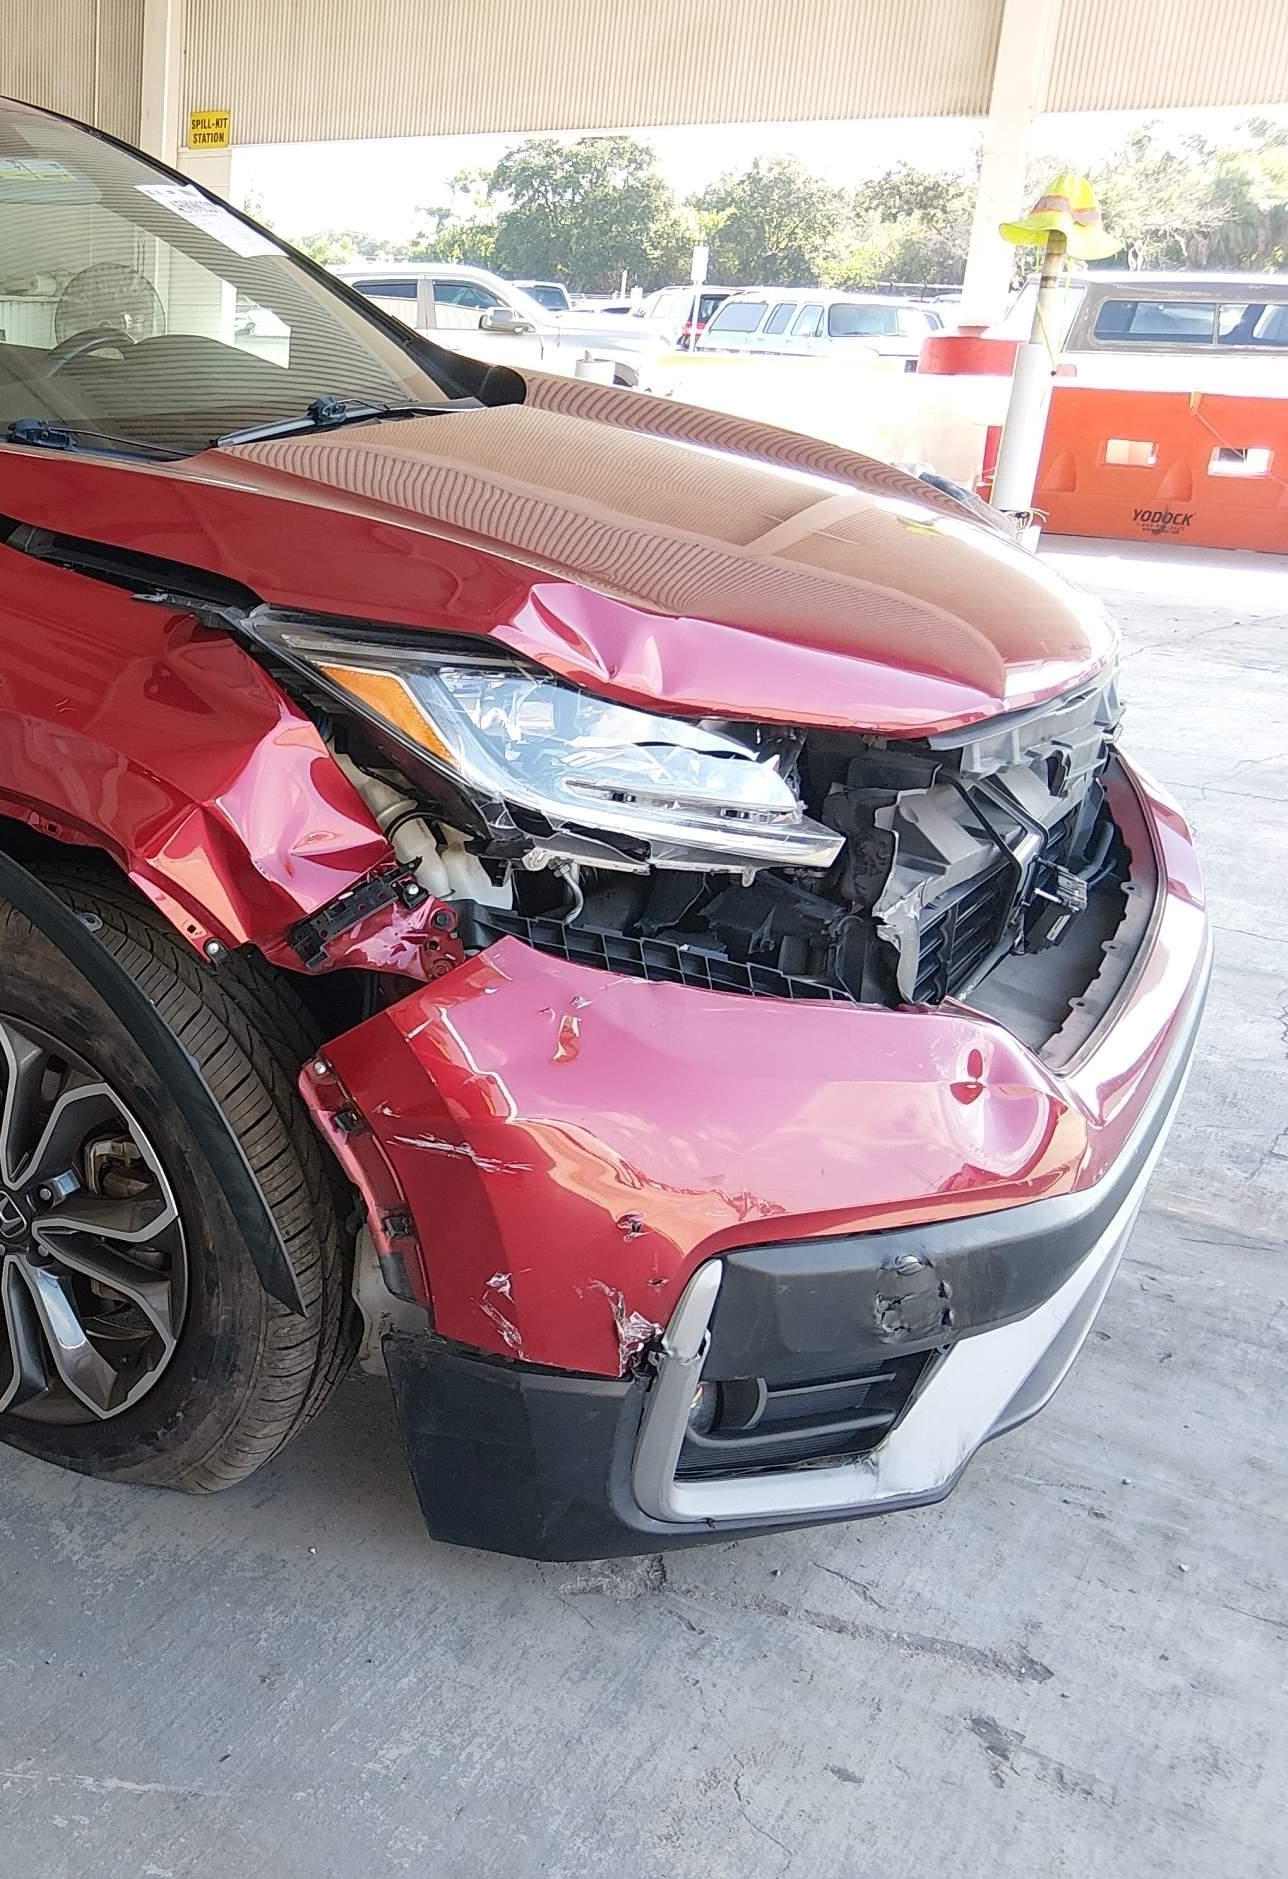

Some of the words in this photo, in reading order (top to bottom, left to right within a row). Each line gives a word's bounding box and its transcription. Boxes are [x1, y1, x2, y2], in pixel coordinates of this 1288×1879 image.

[191, 117, 228, 130] SPILL-KIT
[192, 132, 225, 144] STATION
[1132, 508, 1194, 526] YODOCK
